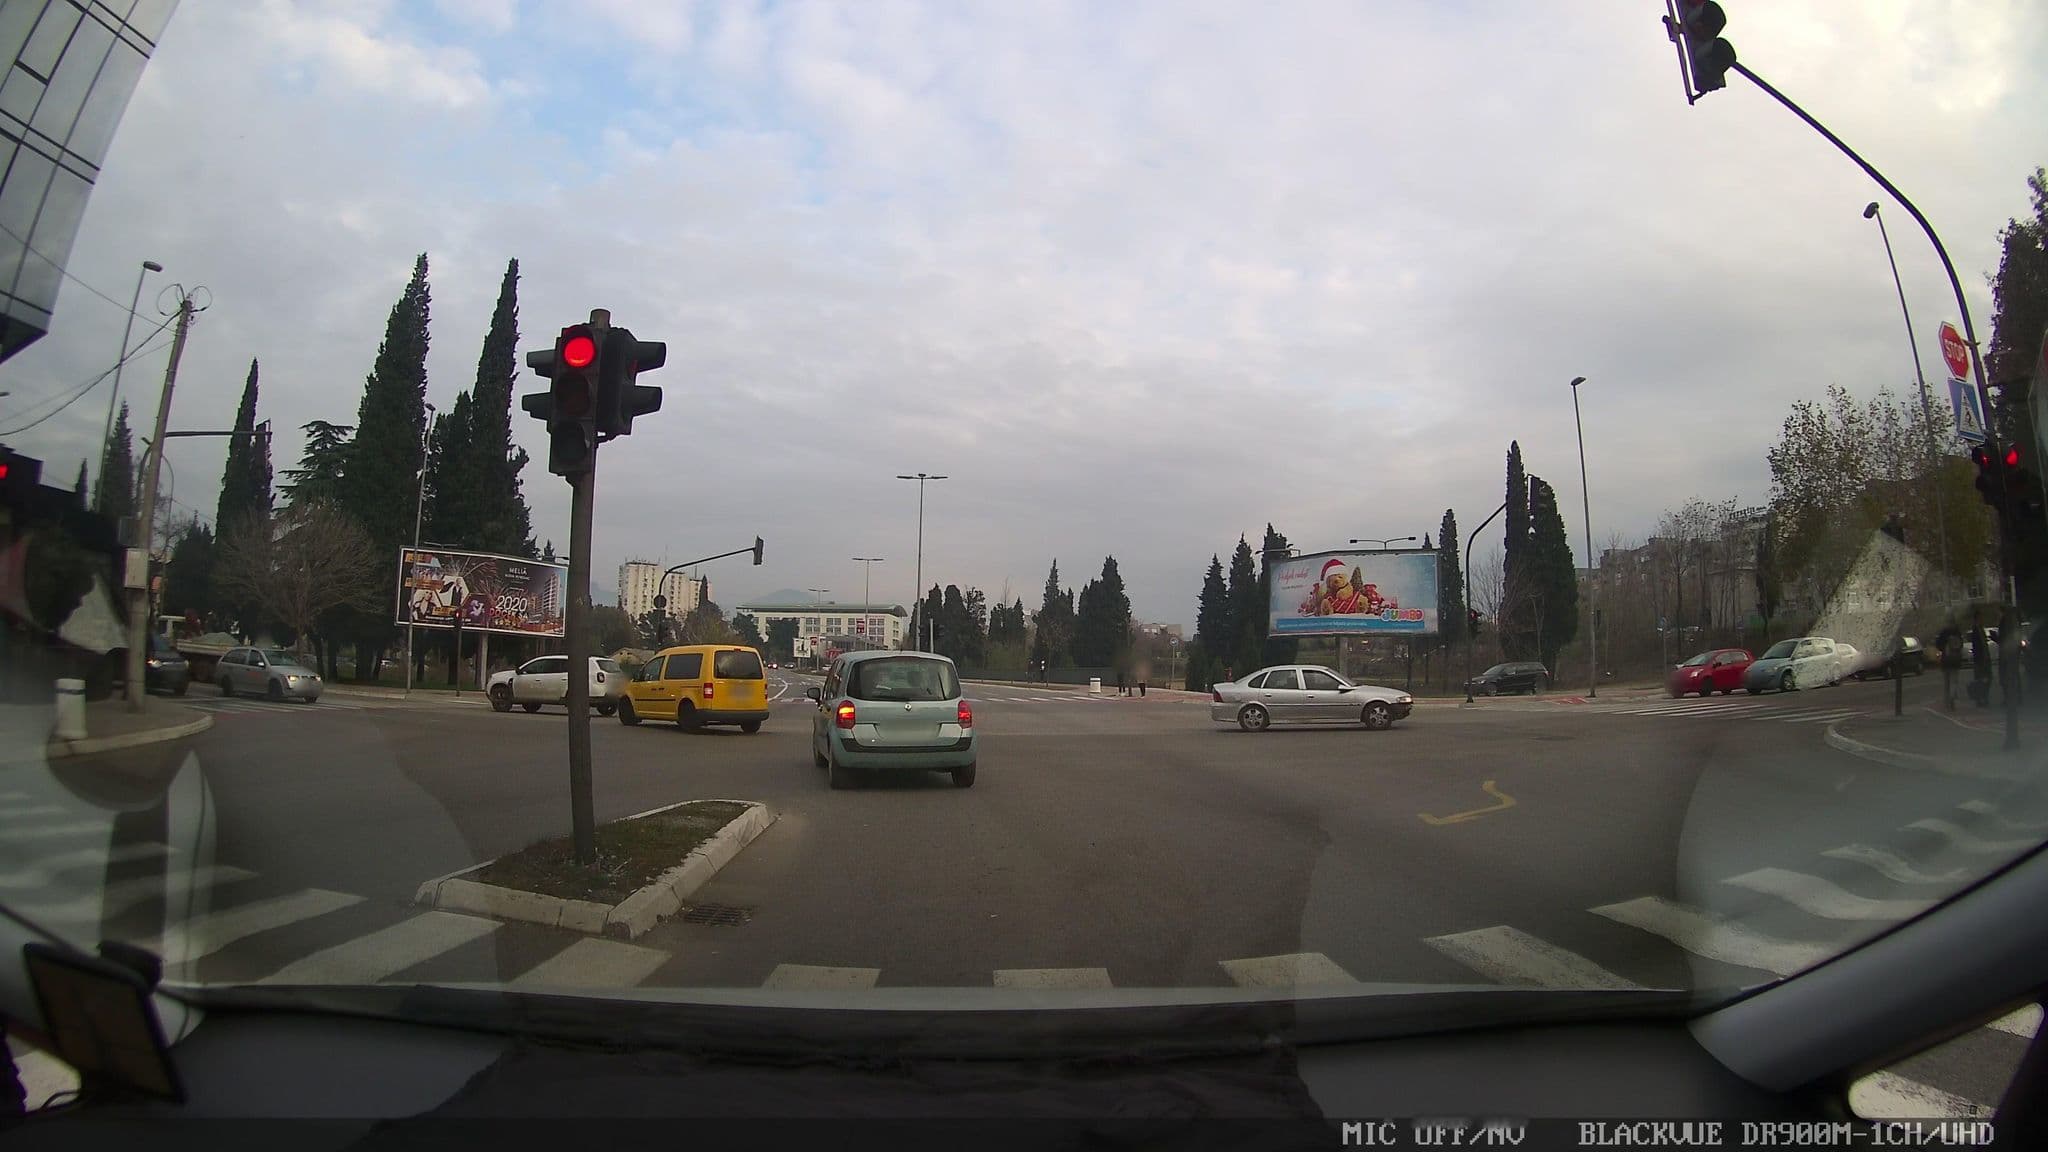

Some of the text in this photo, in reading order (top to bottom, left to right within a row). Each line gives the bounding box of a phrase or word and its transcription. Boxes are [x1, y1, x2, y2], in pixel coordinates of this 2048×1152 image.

[1944, 339, 1964, 363] STOP
[495, 595, 528, 612] 2020
[1382, 608, 1423, 620] JUMBO
